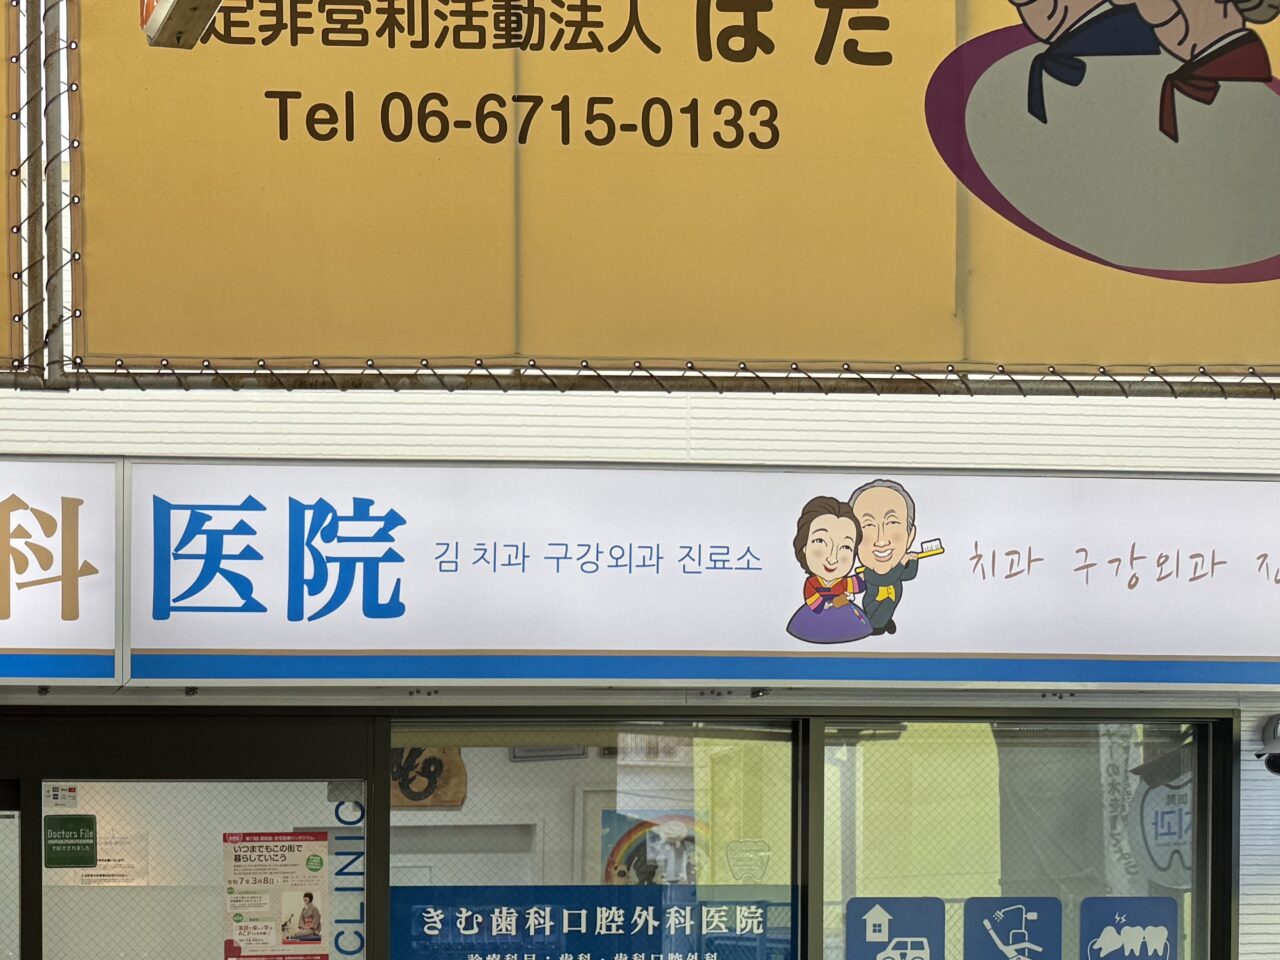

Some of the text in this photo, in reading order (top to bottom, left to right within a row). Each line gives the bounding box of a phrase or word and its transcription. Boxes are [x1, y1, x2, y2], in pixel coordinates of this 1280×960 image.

[200, 0, 662, 53] 定非営利活動法人
[265, 90, 780, 150] Tel 06-6715-0133
[153, 494, 407, 623] 医院
[434, 541, 763, 576] 김 치과 구강외과 진료소
[970, 541, 1045, 580] 치과
[1073, 541, 1228, 590] 구강외과
[47, 829, 94, 838] Doctors File
[234, 844, 303, 853] いつまでもこの街で
[234, 854, 287, 862] 暮らしていこう
[334, 800, 365, 956] CLINIC
[422, 905, 764, 936] きむ歯科口腔外科医院
